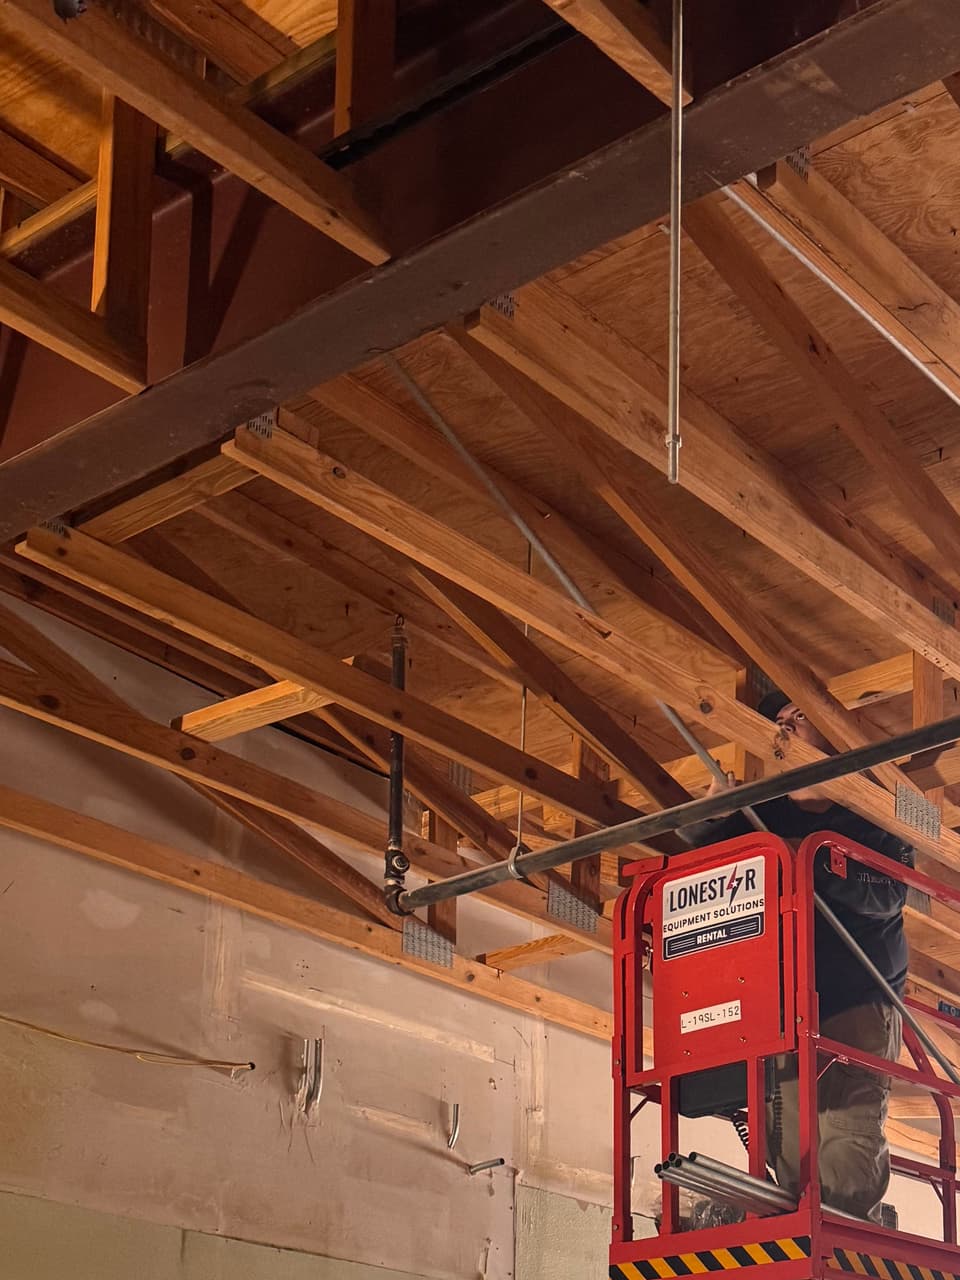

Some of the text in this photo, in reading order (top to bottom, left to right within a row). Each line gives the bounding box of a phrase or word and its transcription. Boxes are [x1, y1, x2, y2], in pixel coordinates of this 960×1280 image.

[663, 898, 764, 933] EQUIPMENT SOLUTIONS
[696, 928, 728, 945] RENTAL
